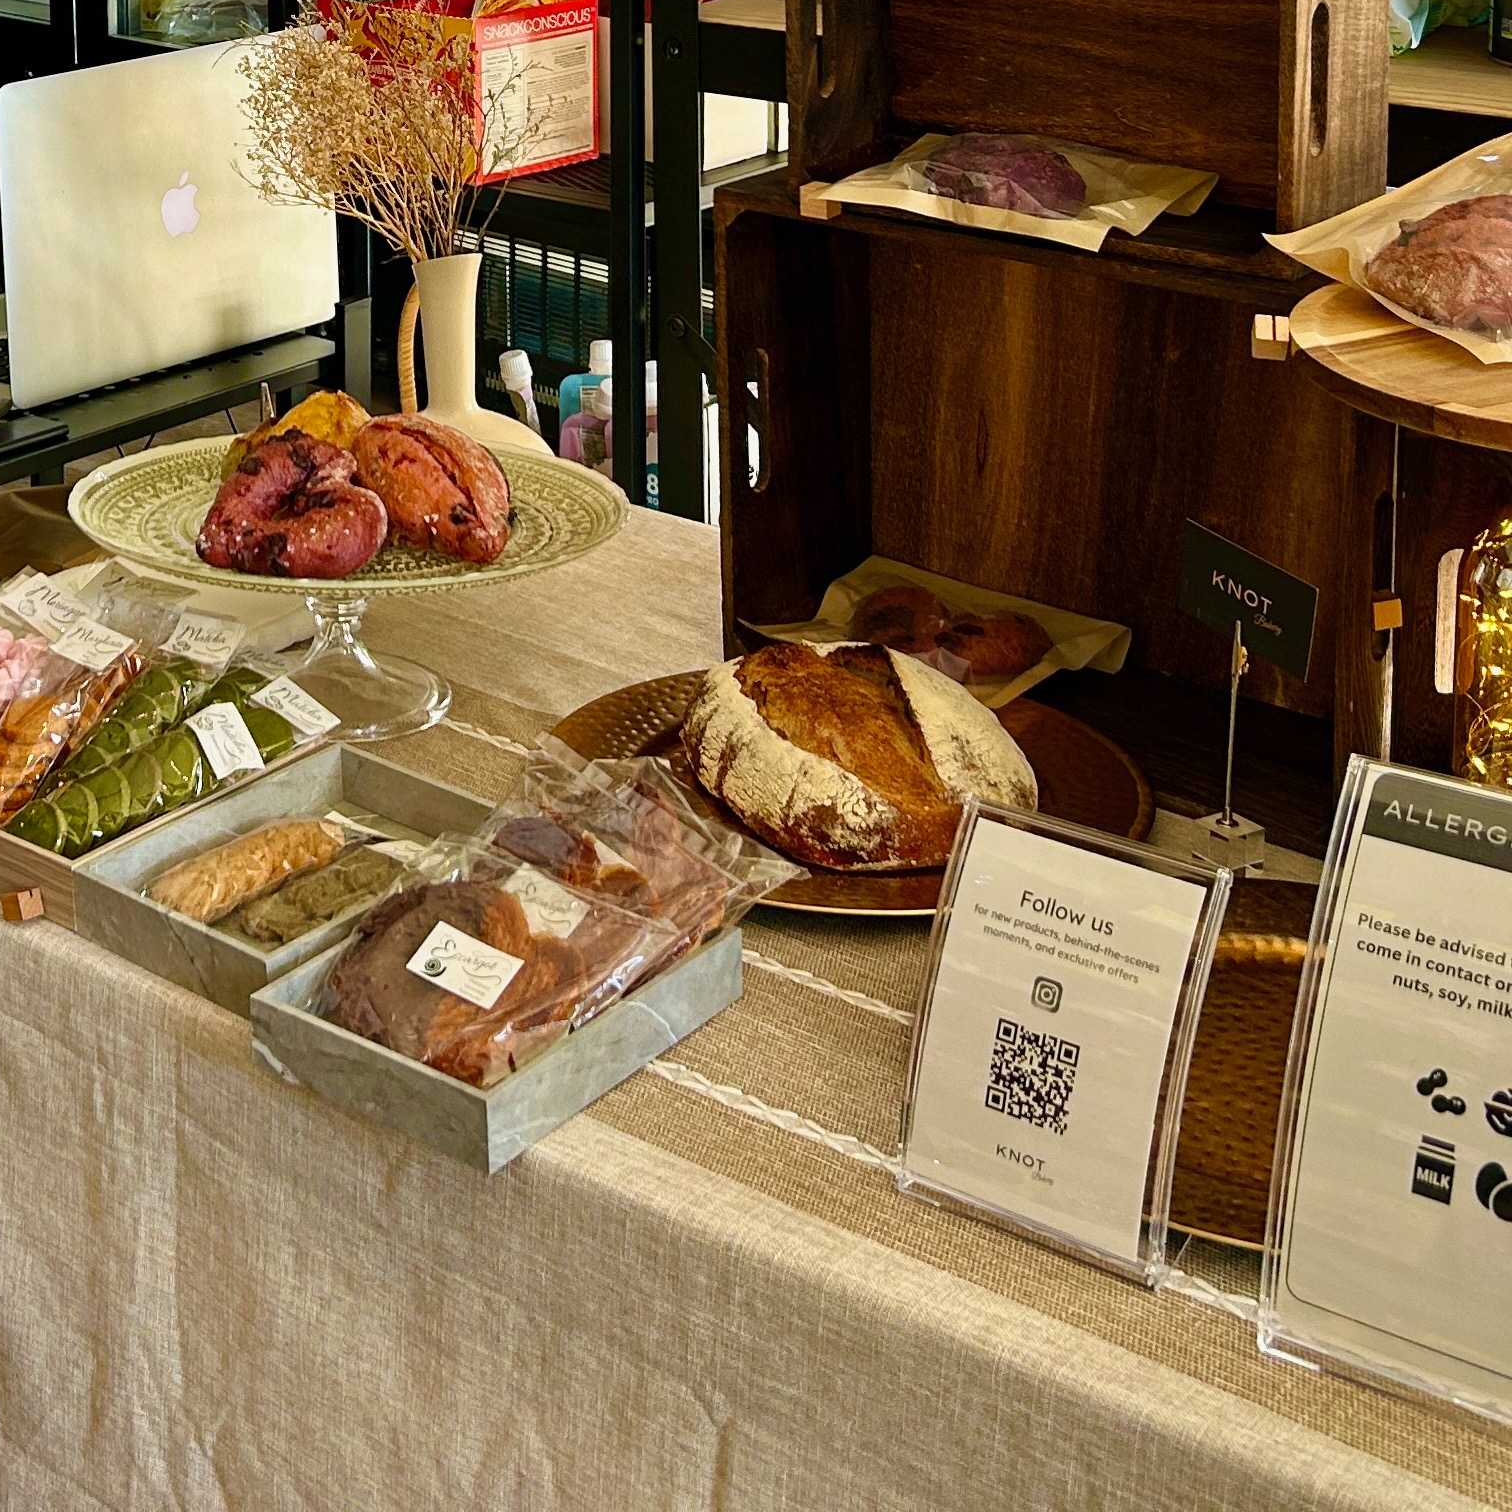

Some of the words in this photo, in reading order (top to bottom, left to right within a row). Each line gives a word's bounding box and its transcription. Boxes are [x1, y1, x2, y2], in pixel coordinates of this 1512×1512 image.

[1212, 570, 1272, 615] KNOT
[1020, 890, 1086, 926] Follow
[1091, 917, 1114, 936] us
[974, 903, 989, 916] for
[991, 910, 1012, 923] new
[1013, 917, 1061, 943] products,
[1064, 933, 1160, 974] behind-the-scenes
[983, 925, 1033, 950] moments,
[1035, 942, 1055, 956] and
[1057, 949, 1105, 972] exclusive
[1107, 966, 1139, 984] offers
[1357, 913, 1412, 939] Please
[1415, 928, 1436, 947] be
[1440, 936, 1506, 966] advised
[1356, 939, 1402, 961] come
[1406, 950, 1421, 967] in
[1426, 959, 1491, 987] contact
[1392, 973, 1435, 1000] nuts,
[1438, 987, 1472, 1010] soy,
[995, 1143, 1046, 1173] KNOT
[1416, 1165, 1450, 1190] MILK
